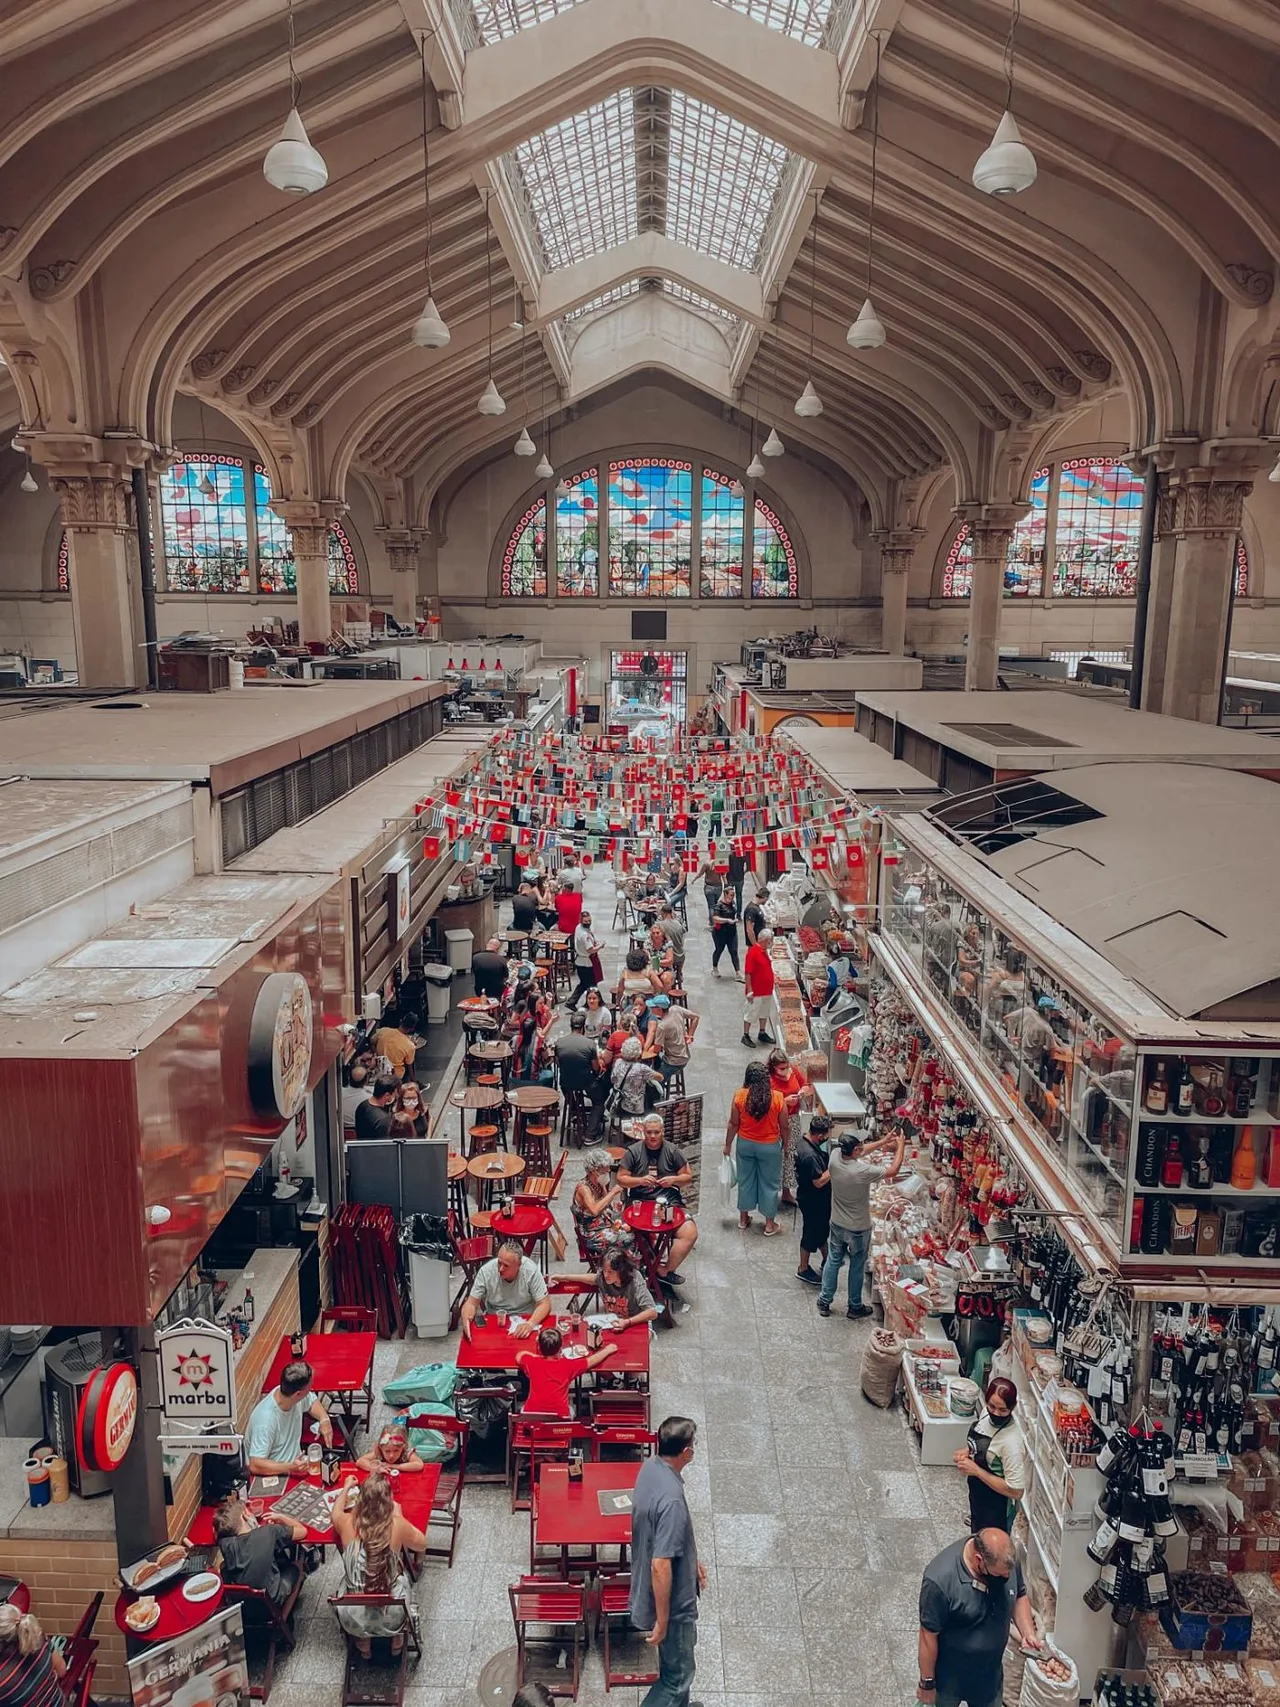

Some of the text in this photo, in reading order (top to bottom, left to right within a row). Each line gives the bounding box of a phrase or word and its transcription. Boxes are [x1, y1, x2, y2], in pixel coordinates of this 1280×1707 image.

[1143, 1128, 1156, 1178] CHANDON
[1149, 1200, 1160, 1248] CHANDON
[168, 1391, 226, 1404] marba
[145, 1635, 231, 1686] GERMÂNIA
